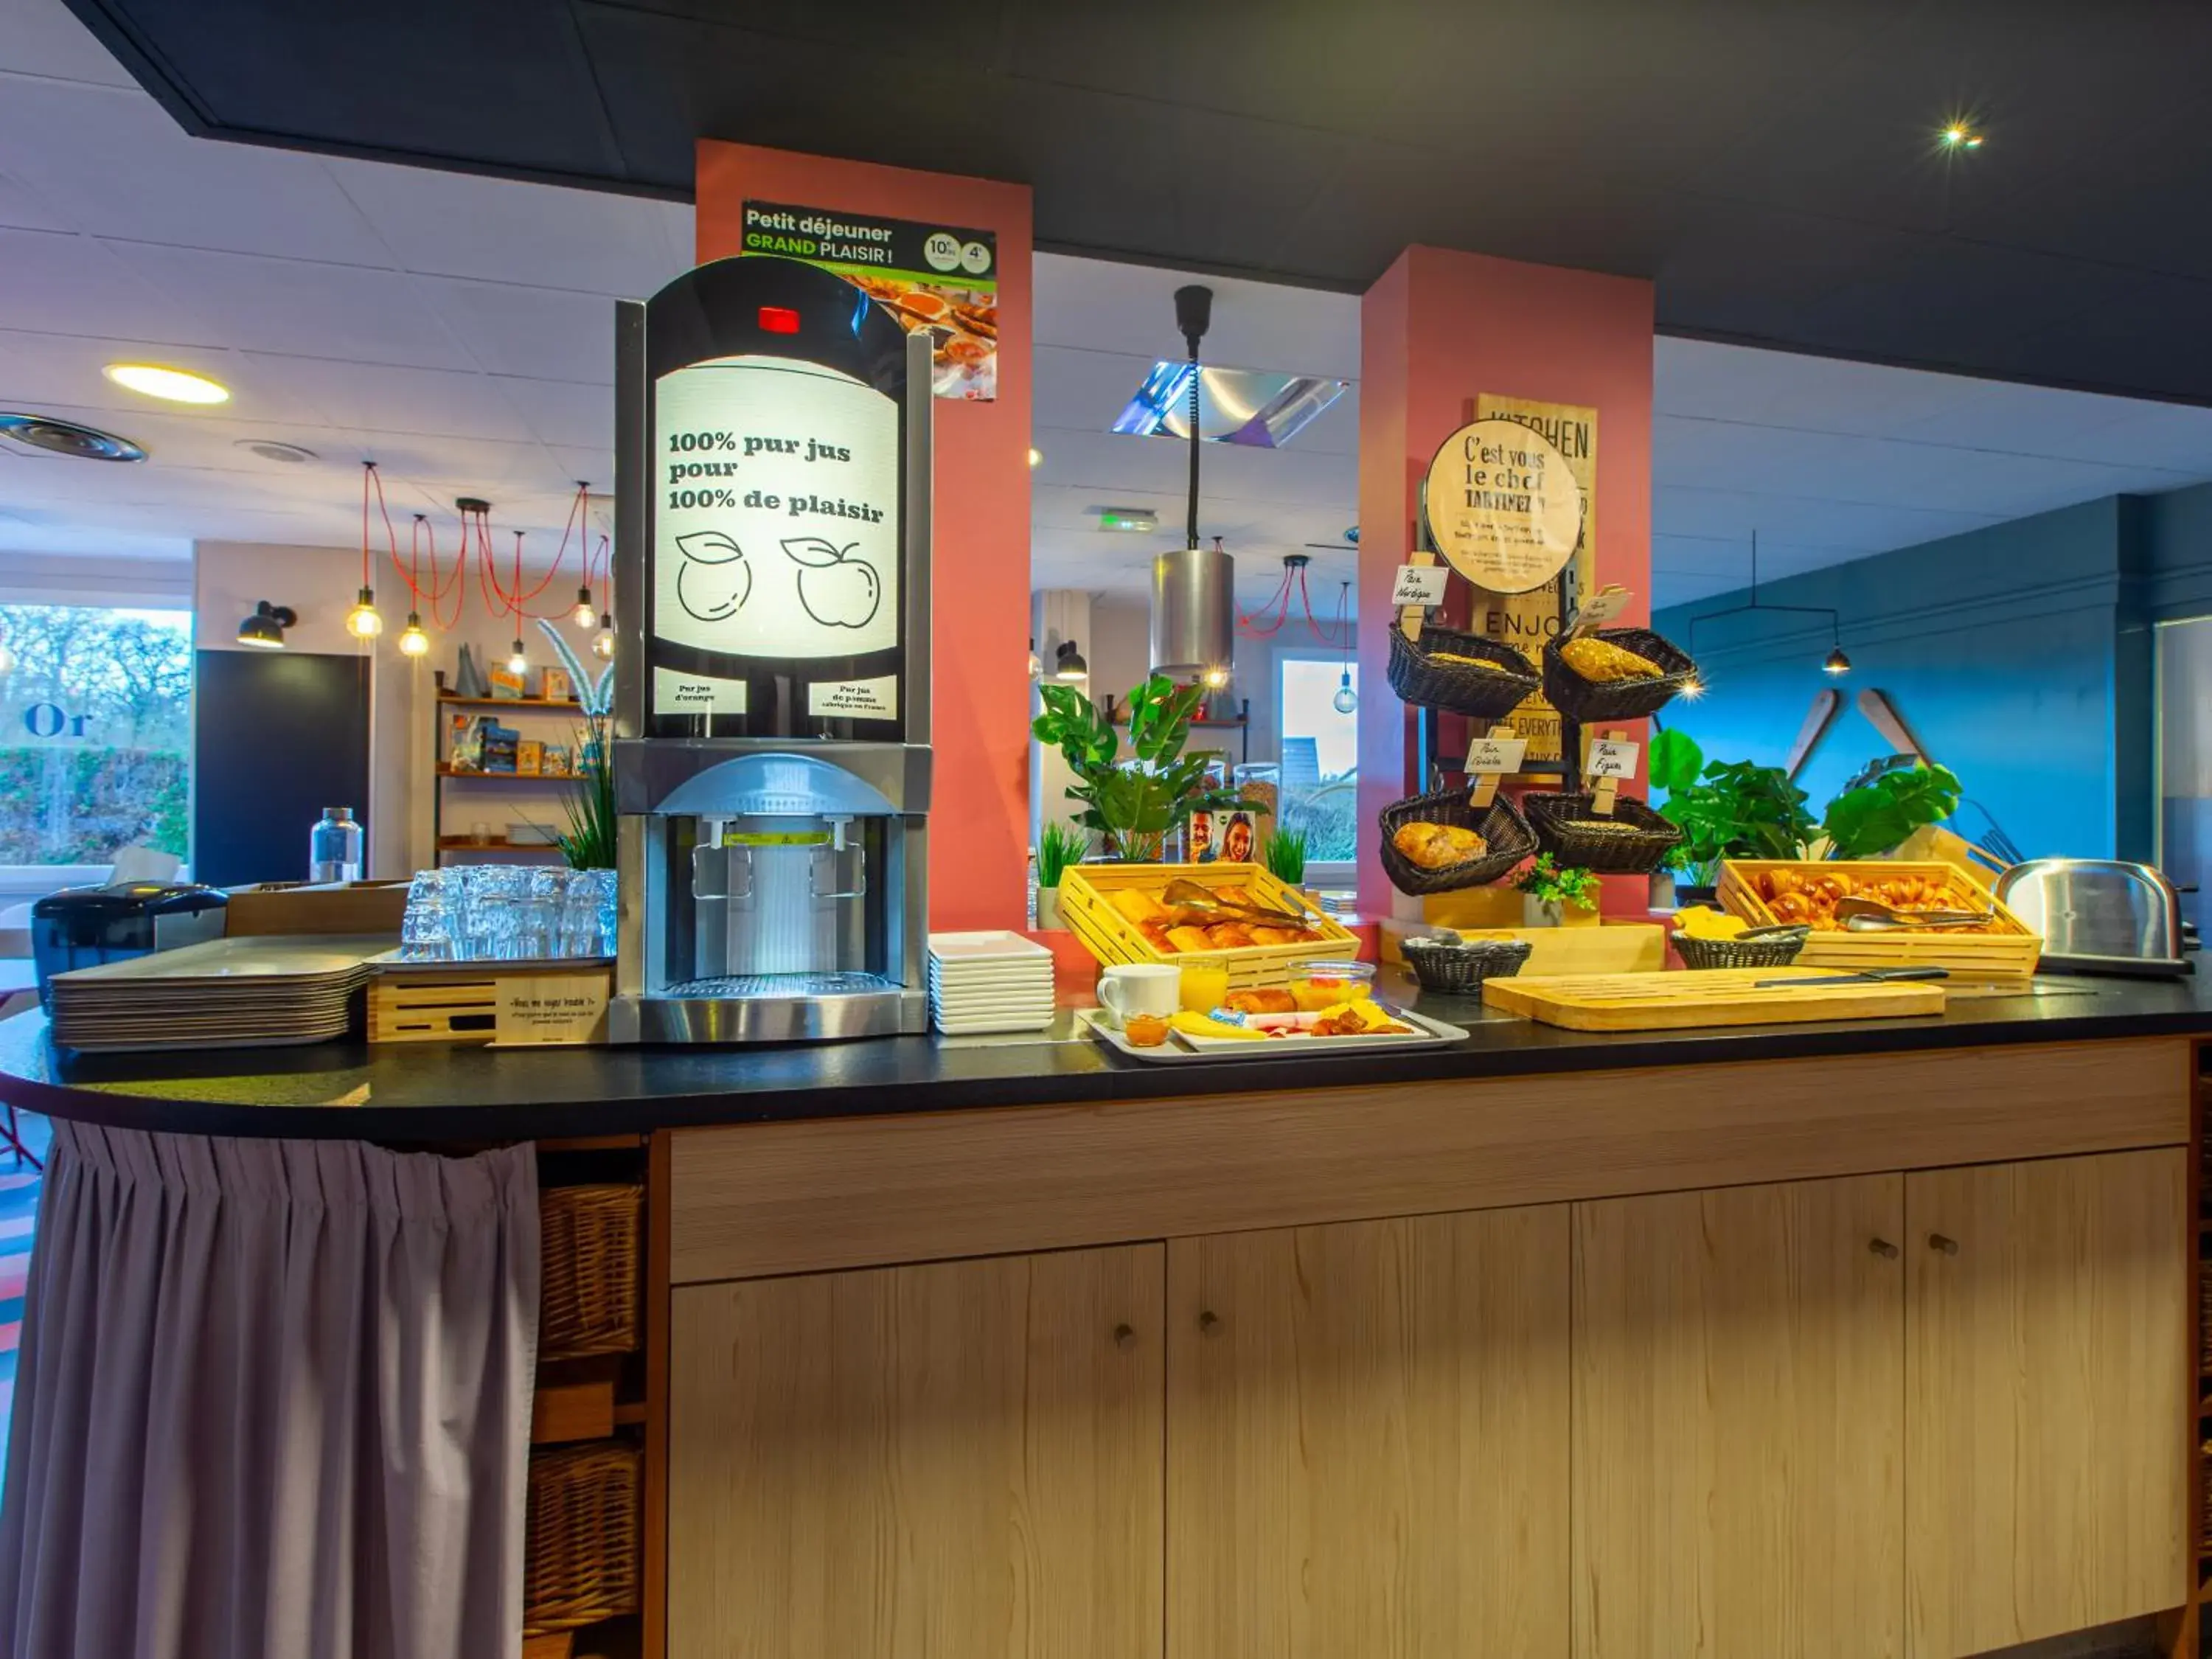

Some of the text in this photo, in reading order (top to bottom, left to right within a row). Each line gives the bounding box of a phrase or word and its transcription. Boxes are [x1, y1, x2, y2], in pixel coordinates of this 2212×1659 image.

[746, 209, 893, 243] Petit déjeuner
[746, 232, 893, 263] GRAND PLAISIR !
[669, 432, 851, 462] 100% pur jus
[1464, 436, 1545, 470] C'est vous
[669, 462, 738, 484] pour
[1466, 464, 1545, 490] le chef
[669, 489, 884, 524] 100% de plaisir
[1486, 611, 1560, 636] ENJO
[696, 685, 711, 694] jus
[857, 686, 870, 695] jus
[25, 703, 94, 737] Or
